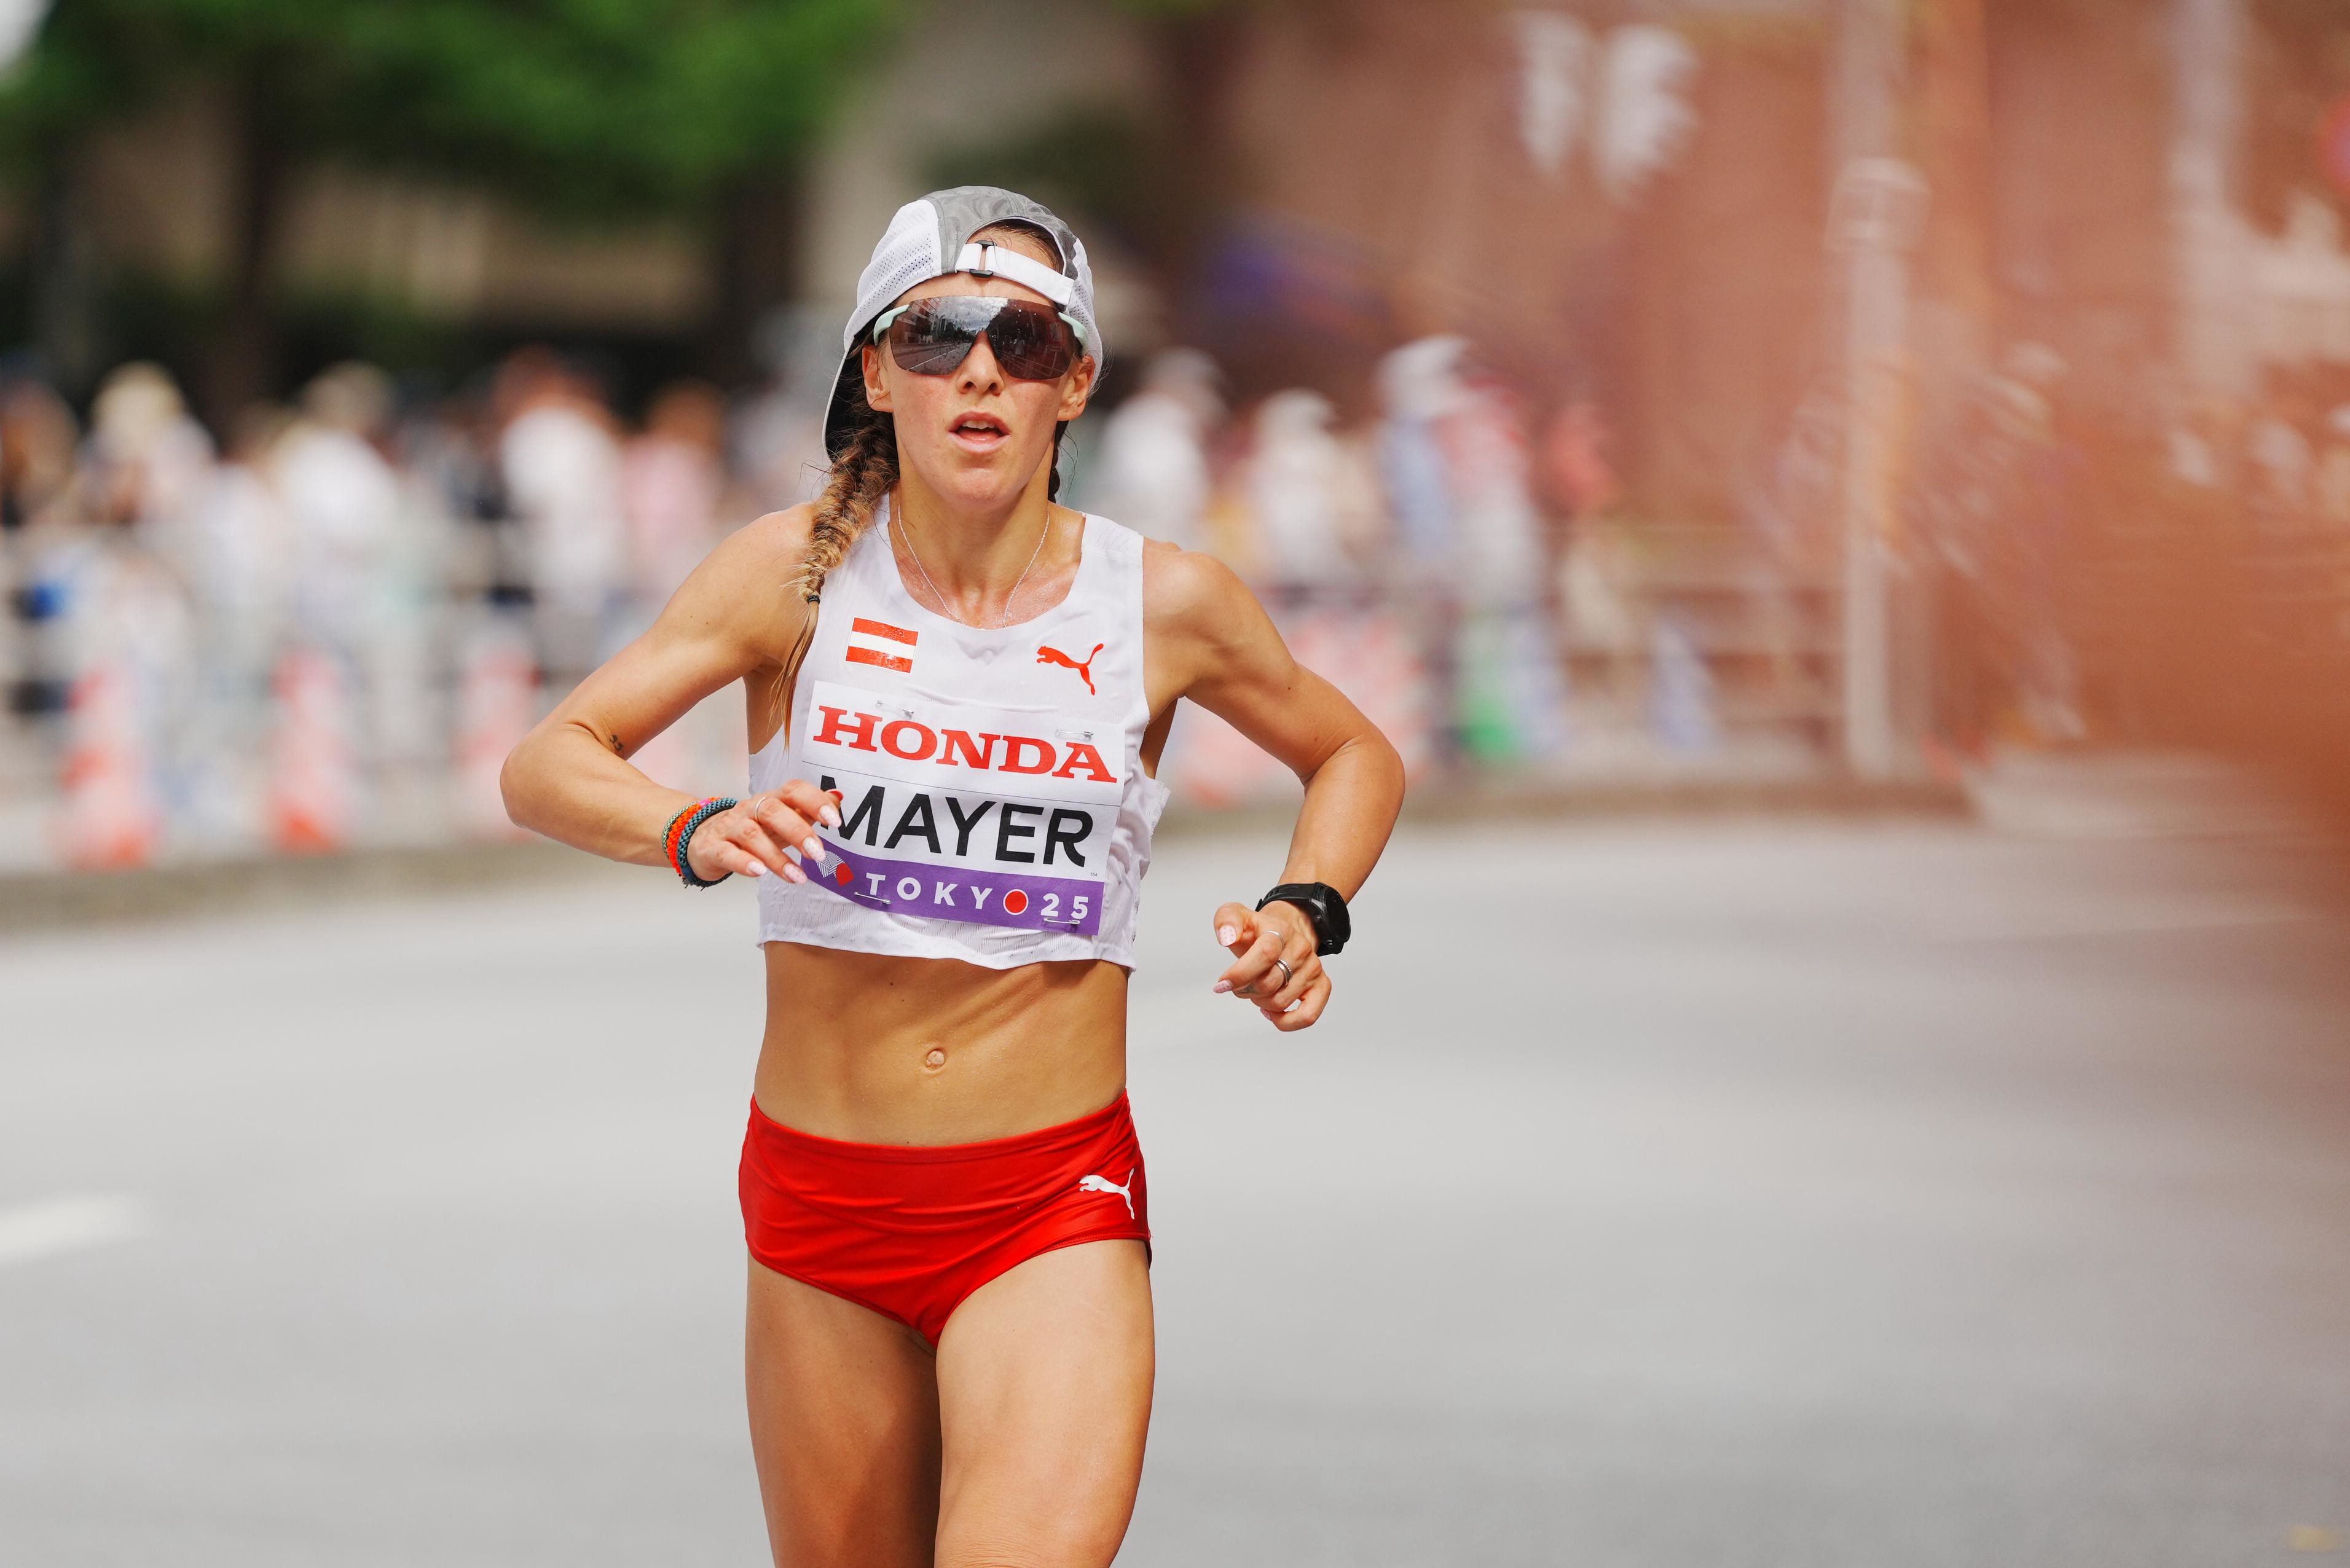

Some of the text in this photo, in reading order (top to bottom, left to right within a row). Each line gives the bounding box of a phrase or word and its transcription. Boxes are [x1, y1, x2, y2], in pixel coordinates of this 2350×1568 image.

[813, 705, 1117, 783] HONDA
[820, 775, 1093, 867] MAYER
[1040, 893, 1089, 920] 25
